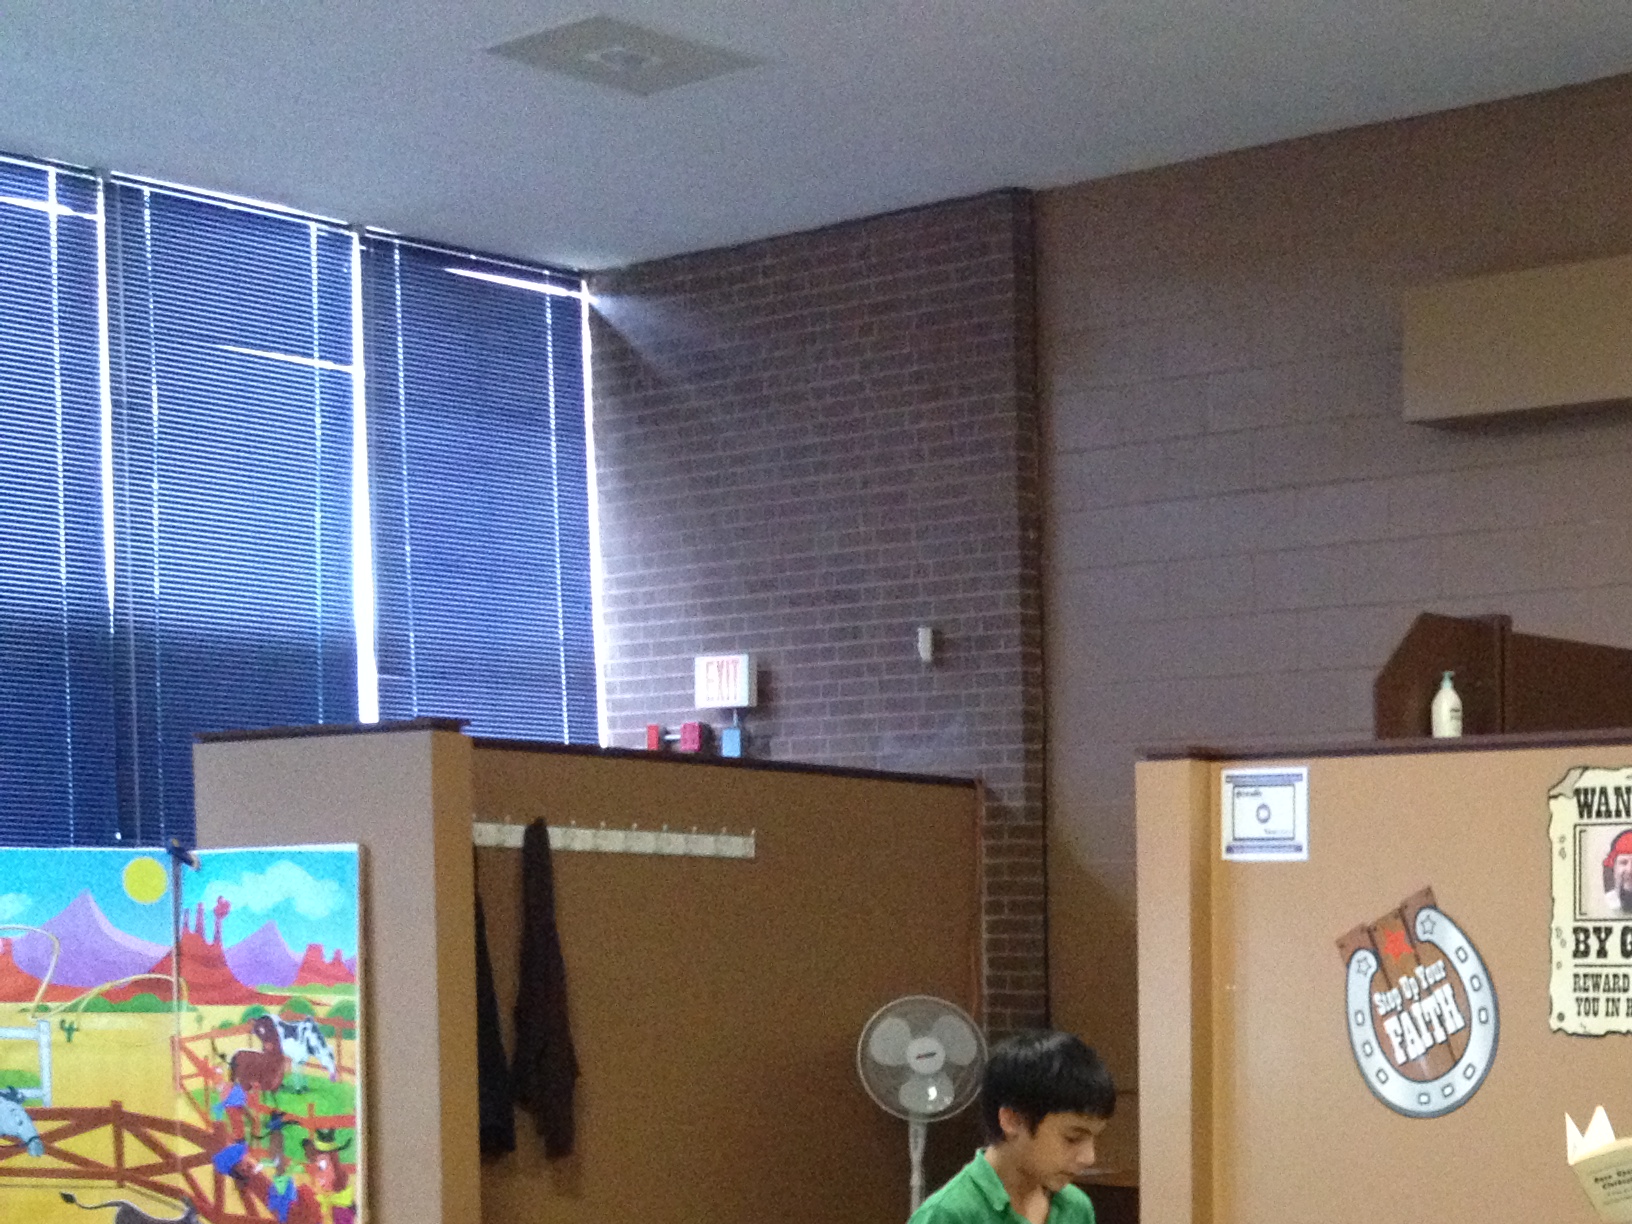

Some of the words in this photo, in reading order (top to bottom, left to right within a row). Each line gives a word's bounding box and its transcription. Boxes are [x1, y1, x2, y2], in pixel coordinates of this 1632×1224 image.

[705, 658, 740, 702] EXIT
[1572, 926, 1613, 959] BY
[1398, 975, 1421, 1002] Up
[1572, 973, 1630, 995] REWARD
[1575, 997, 1600, 1018] YOU
[1605, 998, 1621, 1018] IN
[1382, 982, 1466, 1067] FAITH
